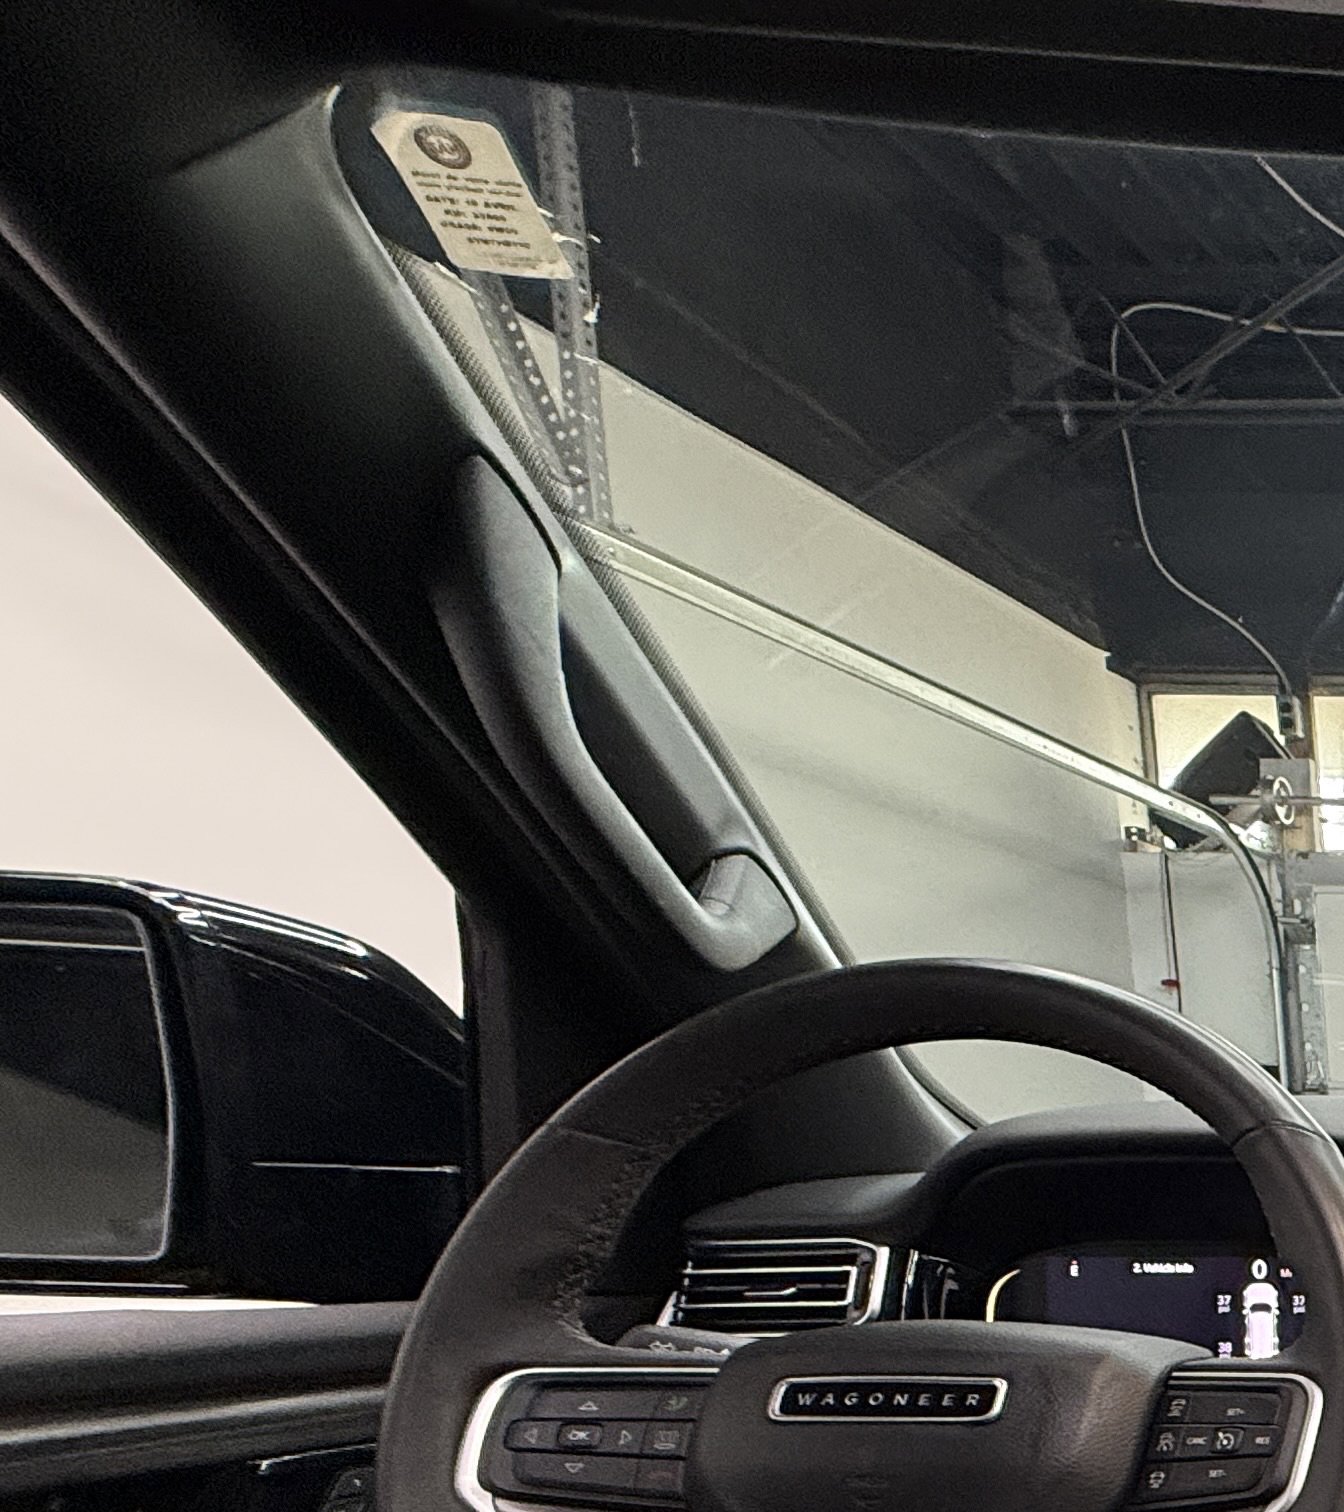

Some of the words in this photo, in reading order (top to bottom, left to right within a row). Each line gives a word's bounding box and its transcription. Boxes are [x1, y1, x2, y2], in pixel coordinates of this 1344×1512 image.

[1251, 1259, 1268, 1280] 0
[1217, 1295, 1232, 1306] 37
[796, 1392, 980, 1406] WAGONEER
